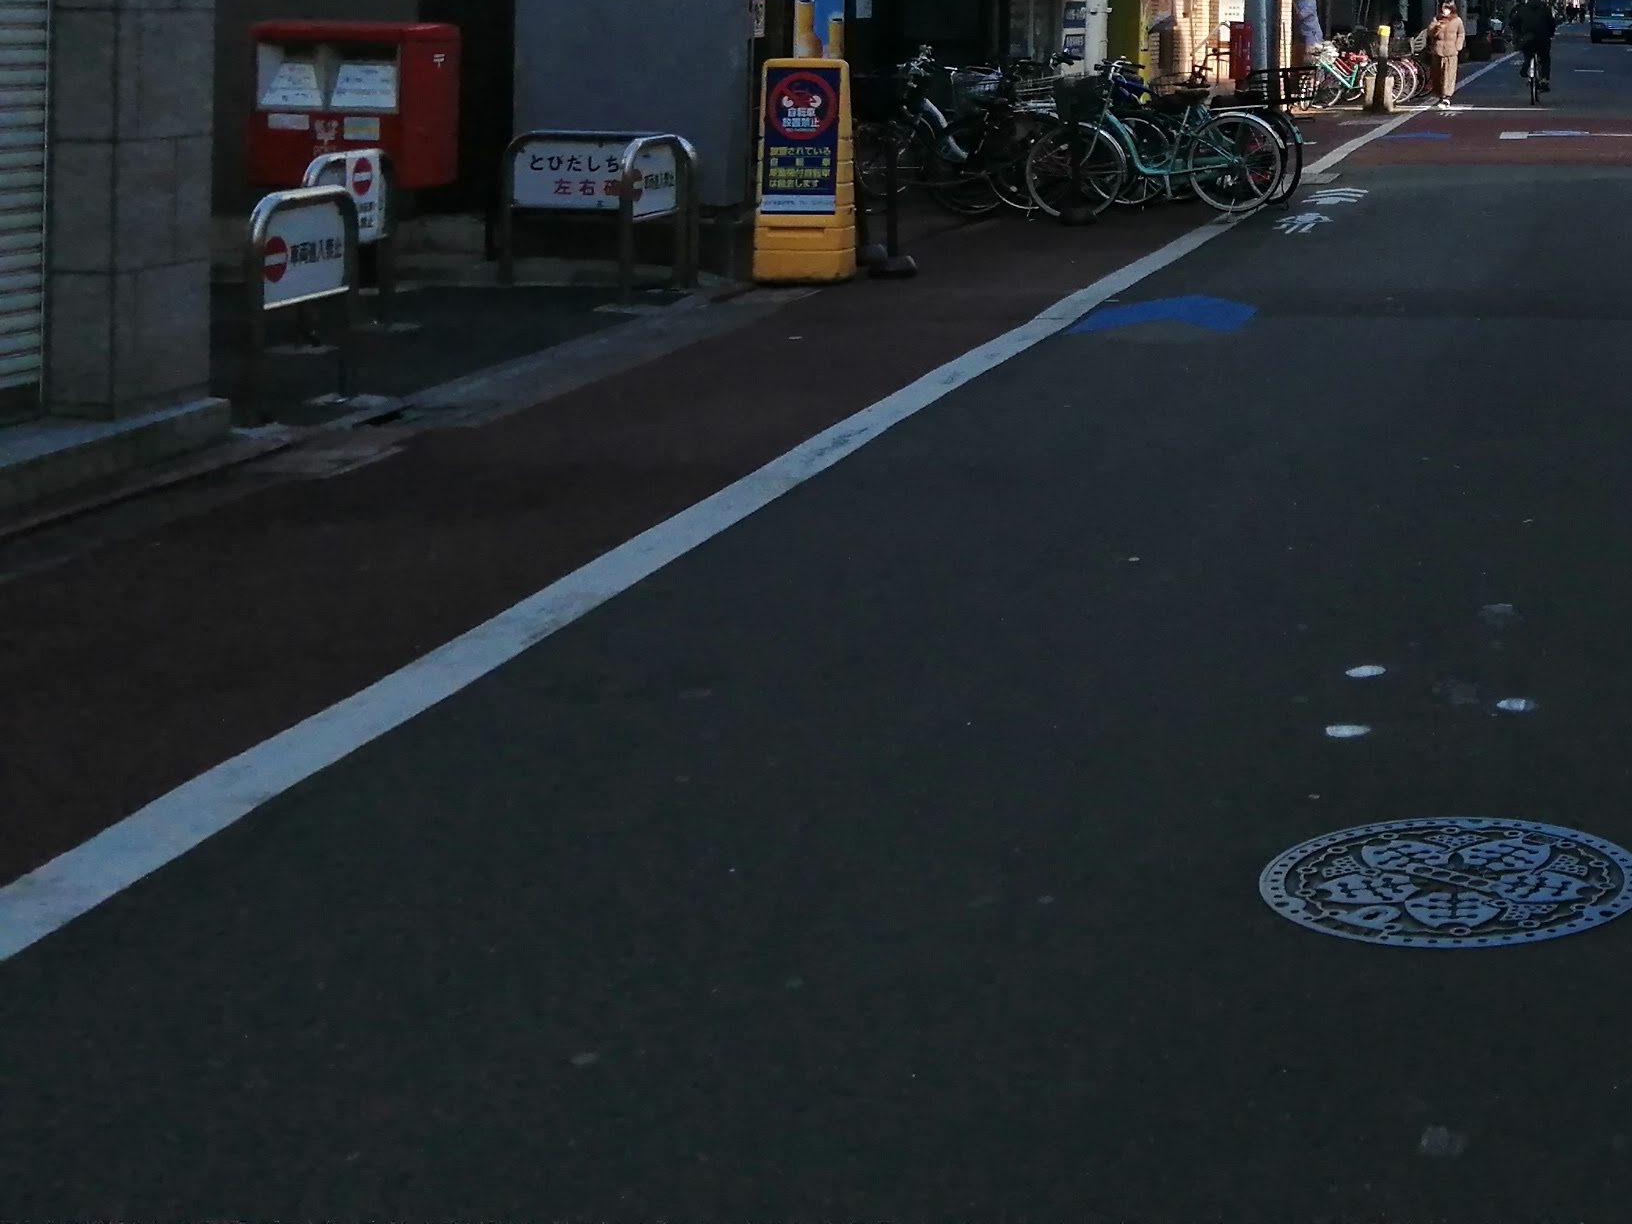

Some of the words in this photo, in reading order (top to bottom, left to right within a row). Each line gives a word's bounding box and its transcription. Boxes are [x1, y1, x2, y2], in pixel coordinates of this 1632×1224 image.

[530, 155, 623, 172] とびだしち
